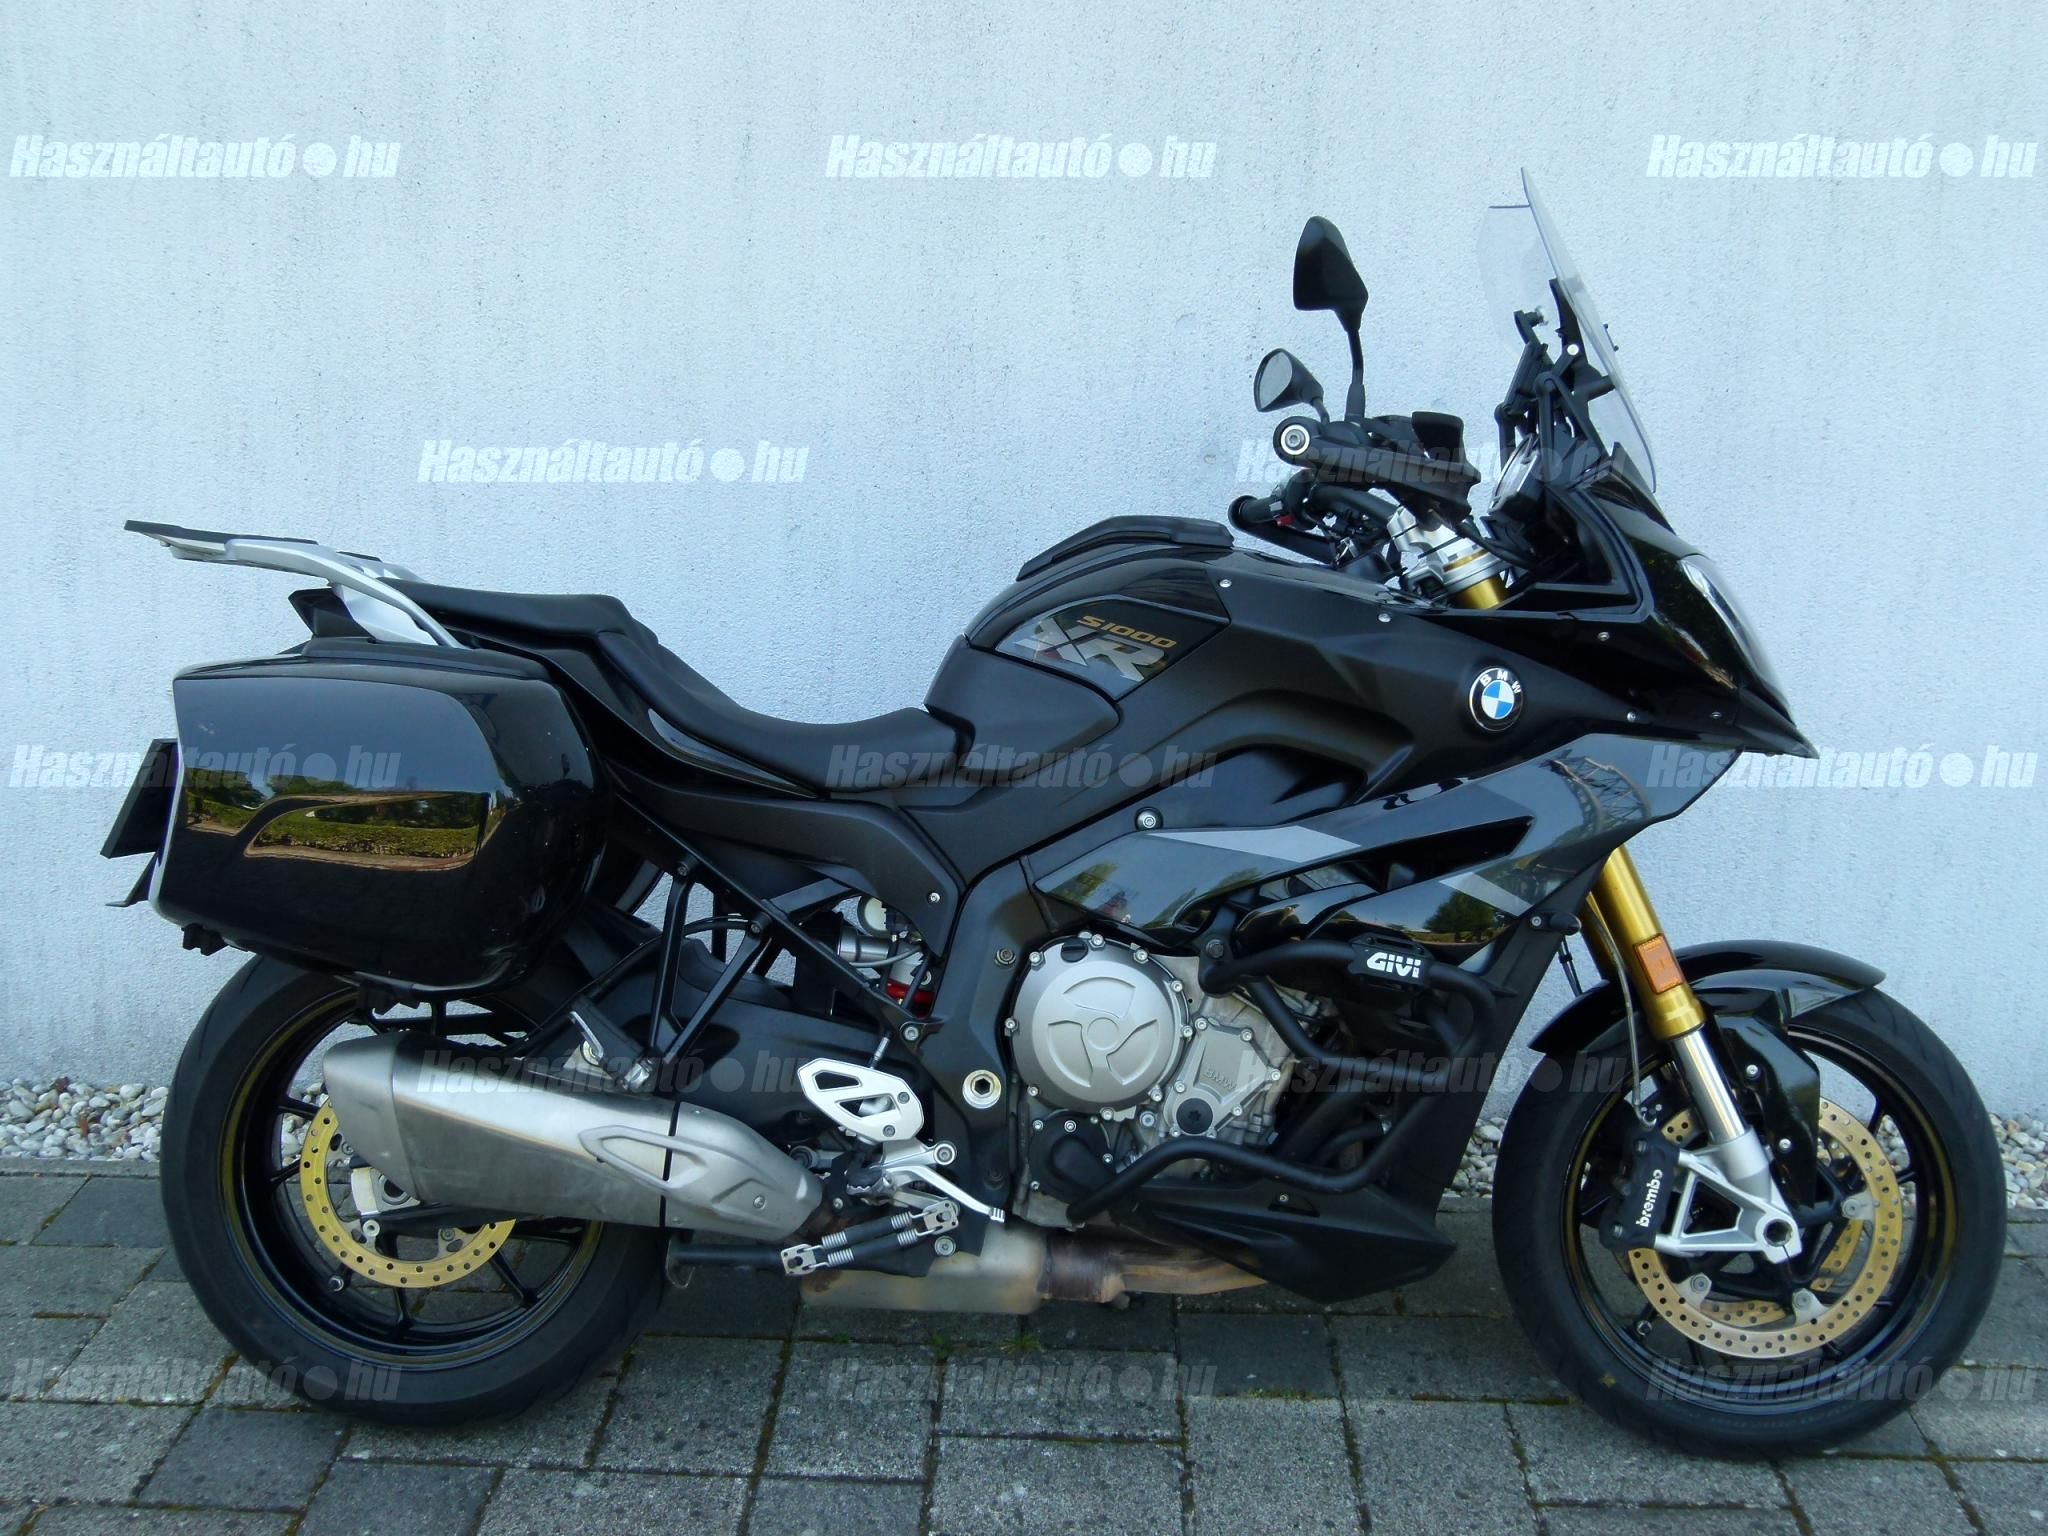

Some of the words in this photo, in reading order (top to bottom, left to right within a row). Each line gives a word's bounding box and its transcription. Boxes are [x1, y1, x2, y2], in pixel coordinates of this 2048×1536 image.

[1014, 617, 1166, 683] XR
[1479, 669, 1521, 694] BMW
[1366, 952, 1422, 979] GIVI
[1635, 1169, 1663, 1228] brembo
